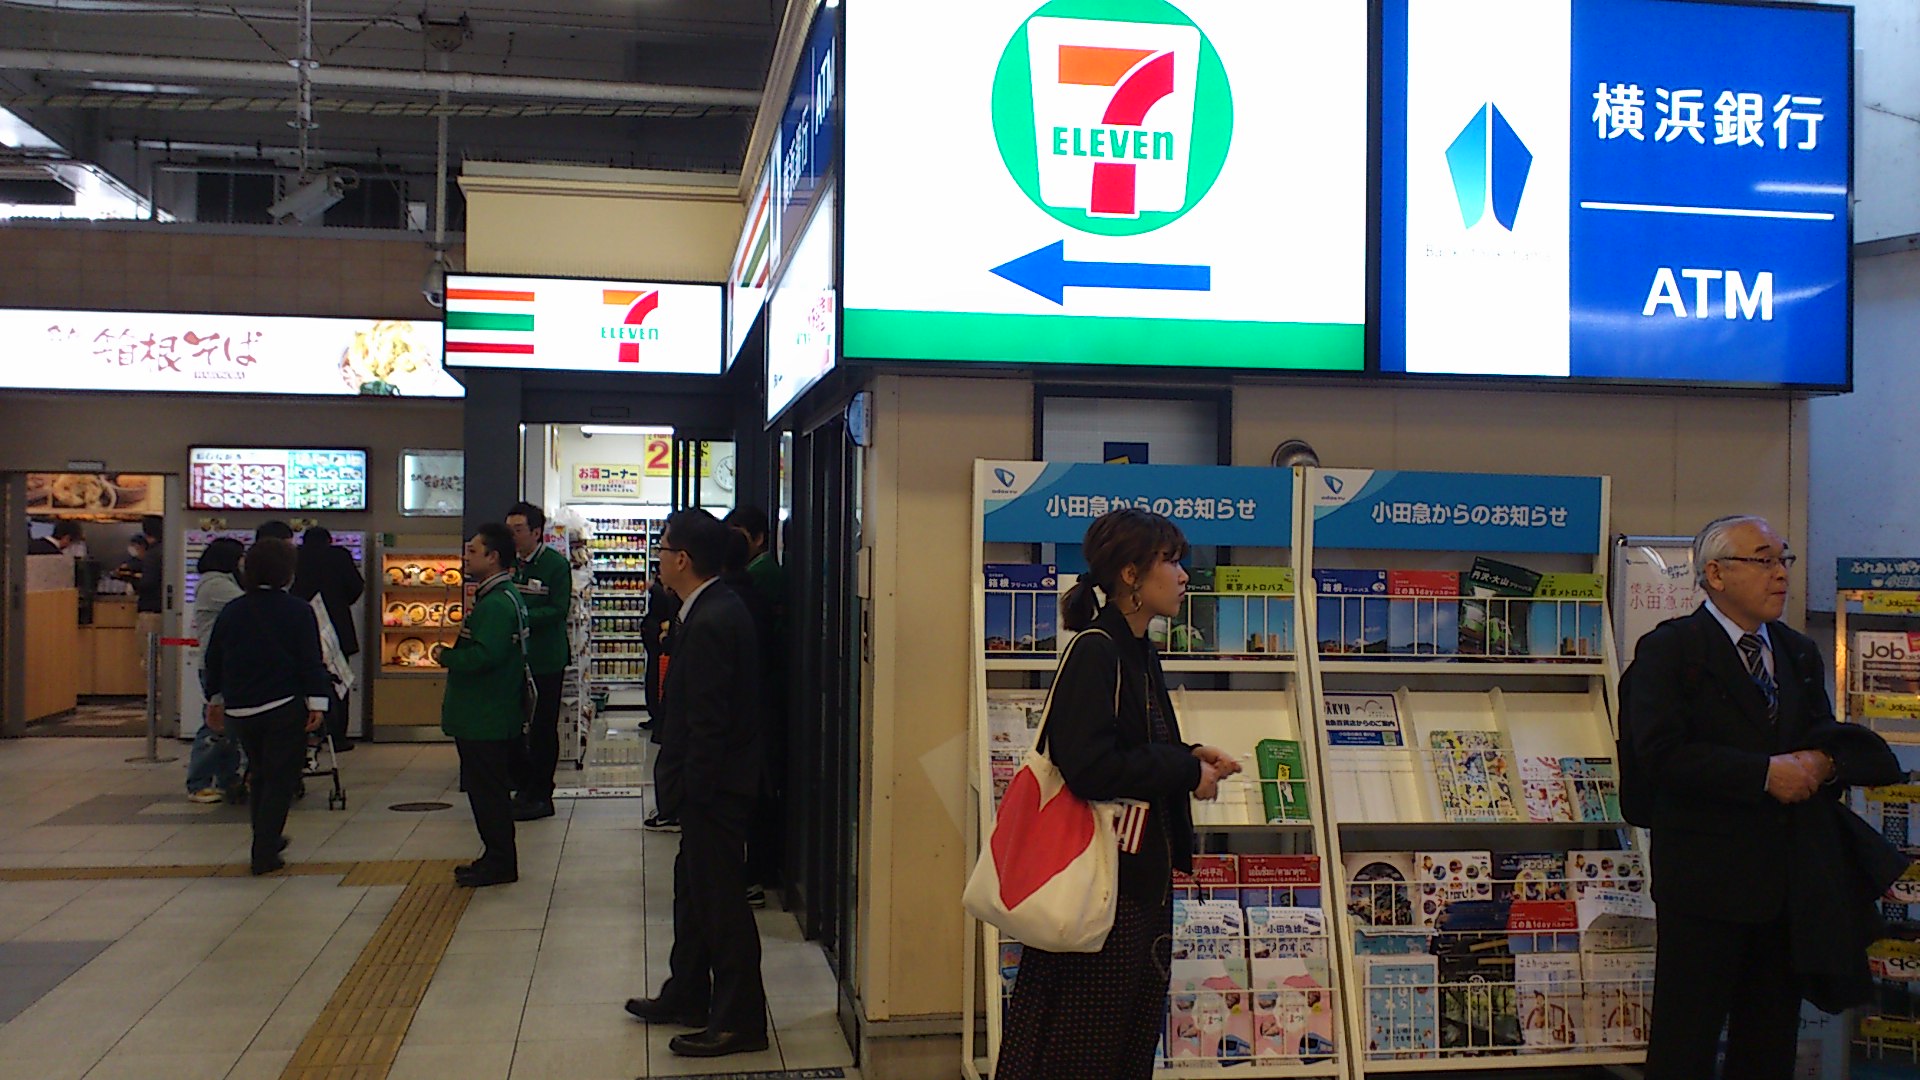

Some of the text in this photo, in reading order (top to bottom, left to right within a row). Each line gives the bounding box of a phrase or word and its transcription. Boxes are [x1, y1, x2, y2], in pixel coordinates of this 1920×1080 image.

[1591, 82, 1825, 150] 横浜銀行
[1642, 267, 1774, 321] ATM
[647, 440, 670, 469] 2
[578, 467, 638, 479] お酒コーナー
[1371, 501, 1568, 528] 小田急からのお知らせ
[1862, 641, 1905, 660] Job
